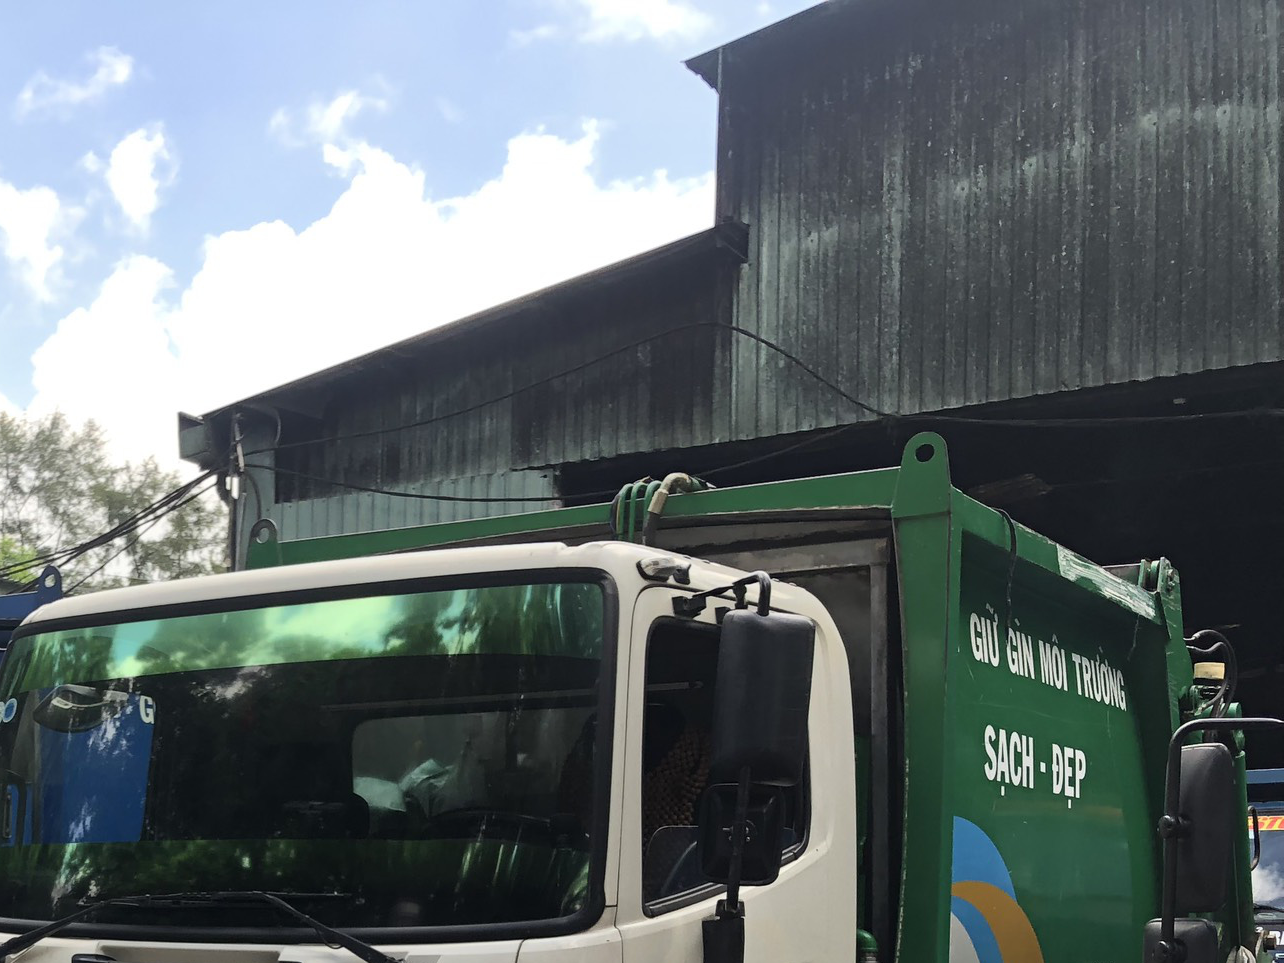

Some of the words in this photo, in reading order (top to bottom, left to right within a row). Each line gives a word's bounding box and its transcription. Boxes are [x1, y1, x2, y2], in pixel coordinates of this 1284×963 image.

[970, 603, 999, 667] GIỮ
[1006, 618, 1035, 680] GÌN
[1038, 634, 1068, 691] MÔI
[1071, 646, 1127, 712] TRƯỜNG
[984, 724, 1034, 796] SẠCH
[1051, 743, 1087, 809] ĐẸP
